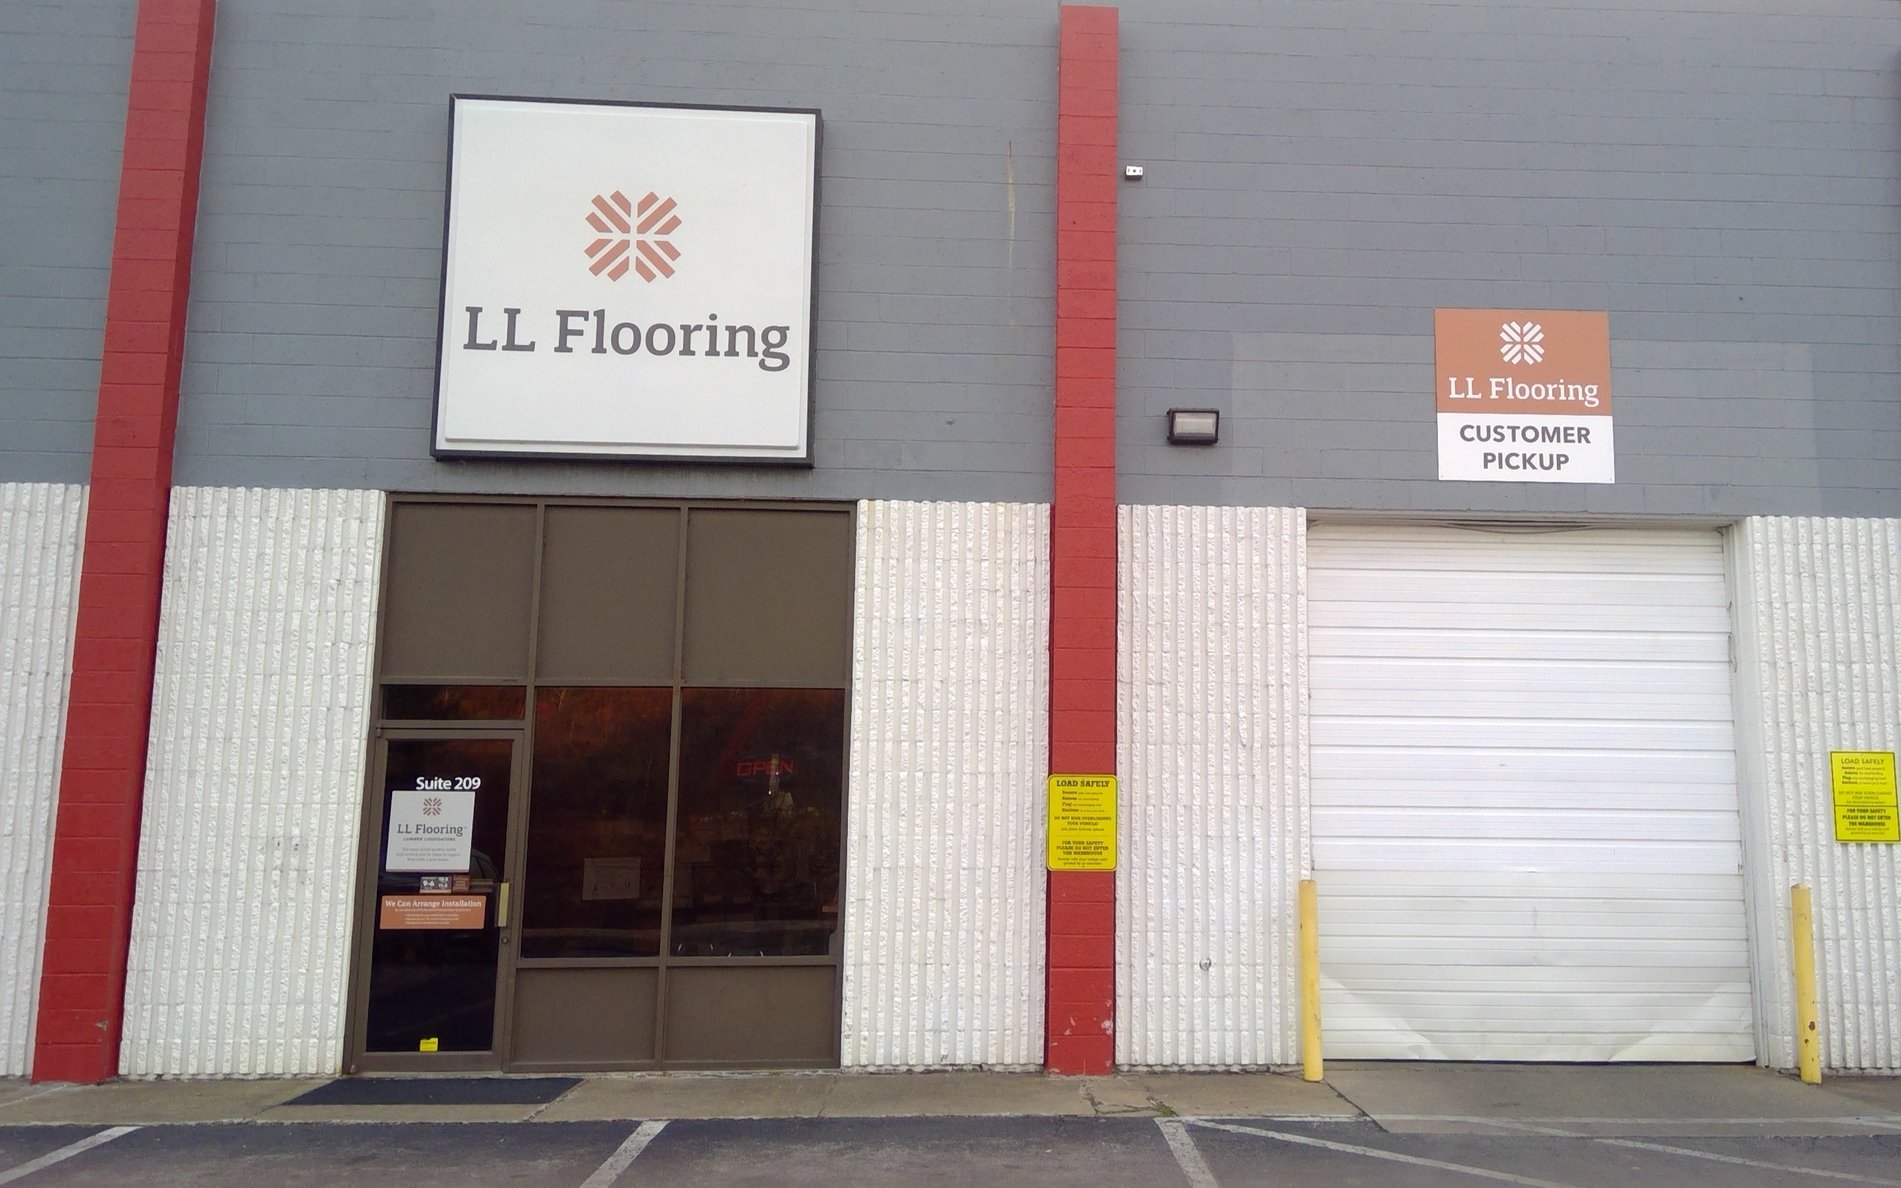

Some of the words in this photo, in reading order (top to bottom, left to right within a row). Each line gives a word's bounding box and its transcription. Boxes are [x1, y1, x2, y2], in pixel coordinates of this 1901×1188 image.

[463, 306, 536, 352] LL
[553, 308, 791, 372] Flooring
[1449, 377, 1482, 399] LL
[1489, 376, 1600, 408] Flooring
[1459, 424, 1591, 444] CUSTOMER
[1483, 452, 1570, 471] PICKUP
[415, 776, 452, 790] Suite
[454, 777, 481, 790] 209
[397, 824, 412, 834] LL
[415, 824, 464, 837] Flooring
[412, 900, 440, 908] Arrange
